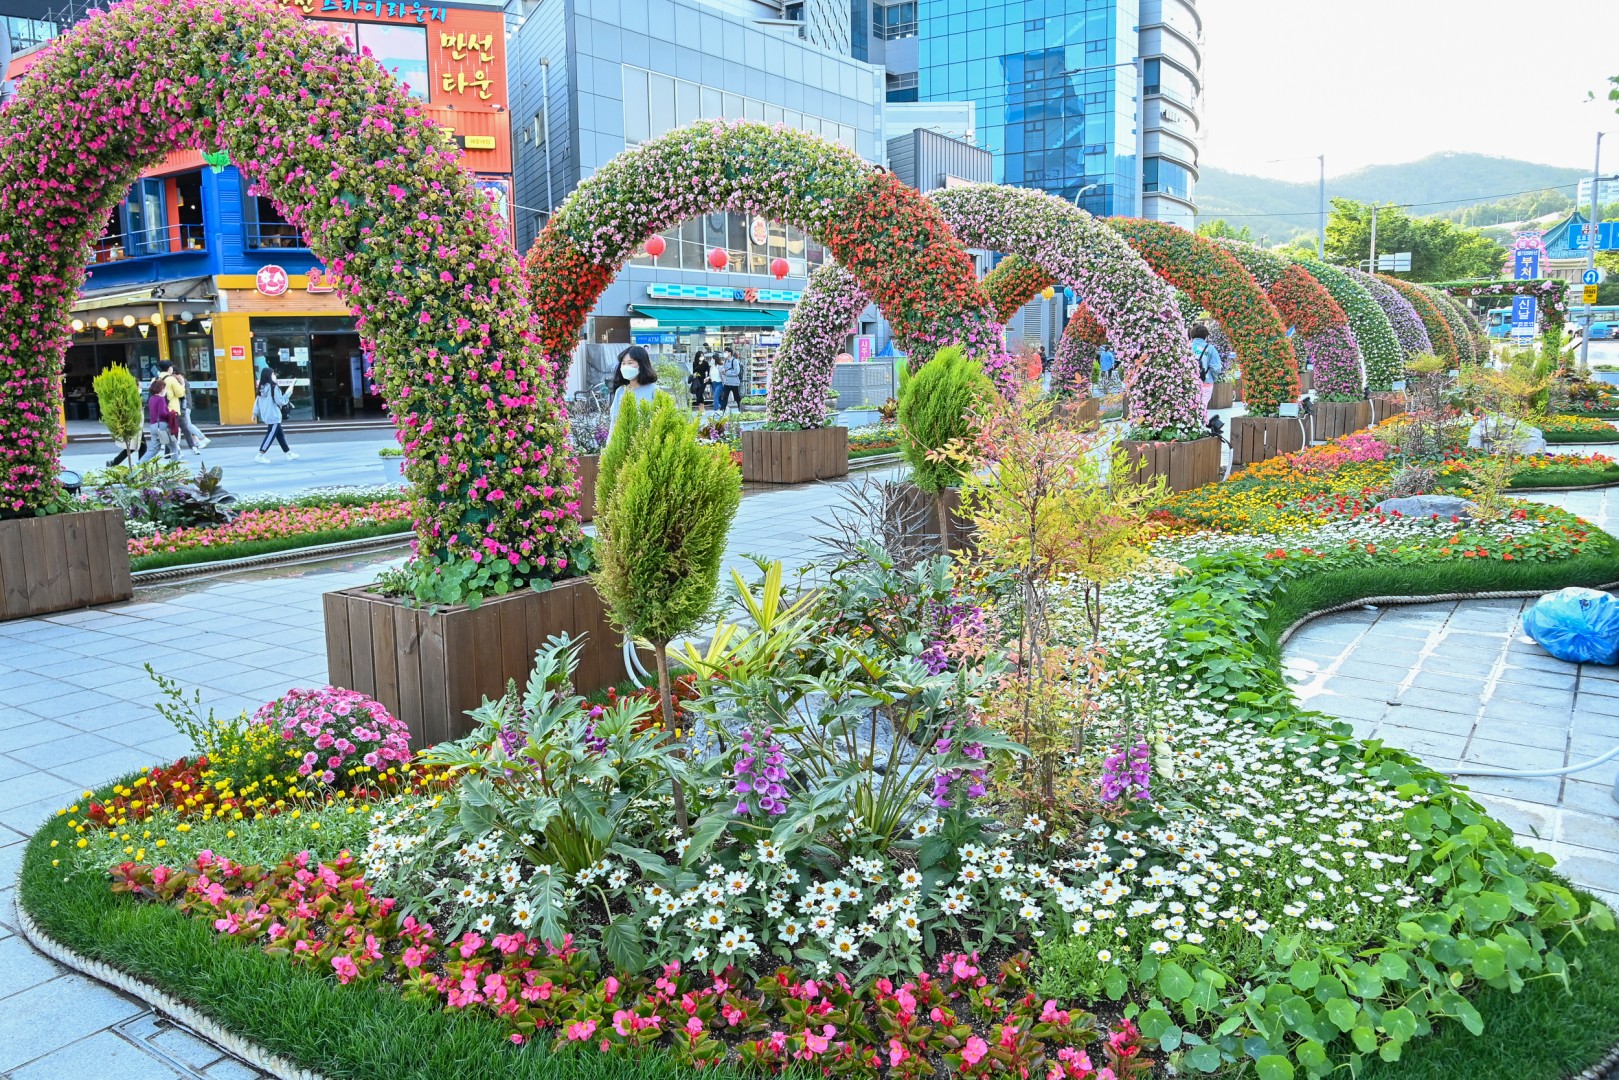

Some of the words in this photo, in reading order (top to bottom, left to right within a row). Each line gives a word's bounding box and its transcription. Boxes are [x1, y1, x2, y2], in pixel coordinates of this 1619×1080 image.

[440, 32, 495, 62] 만선
[441, 70, 494, 100] 타운
[1520, 257, 1534, 280] 부처
[734, 287, 759, 304] GS25
